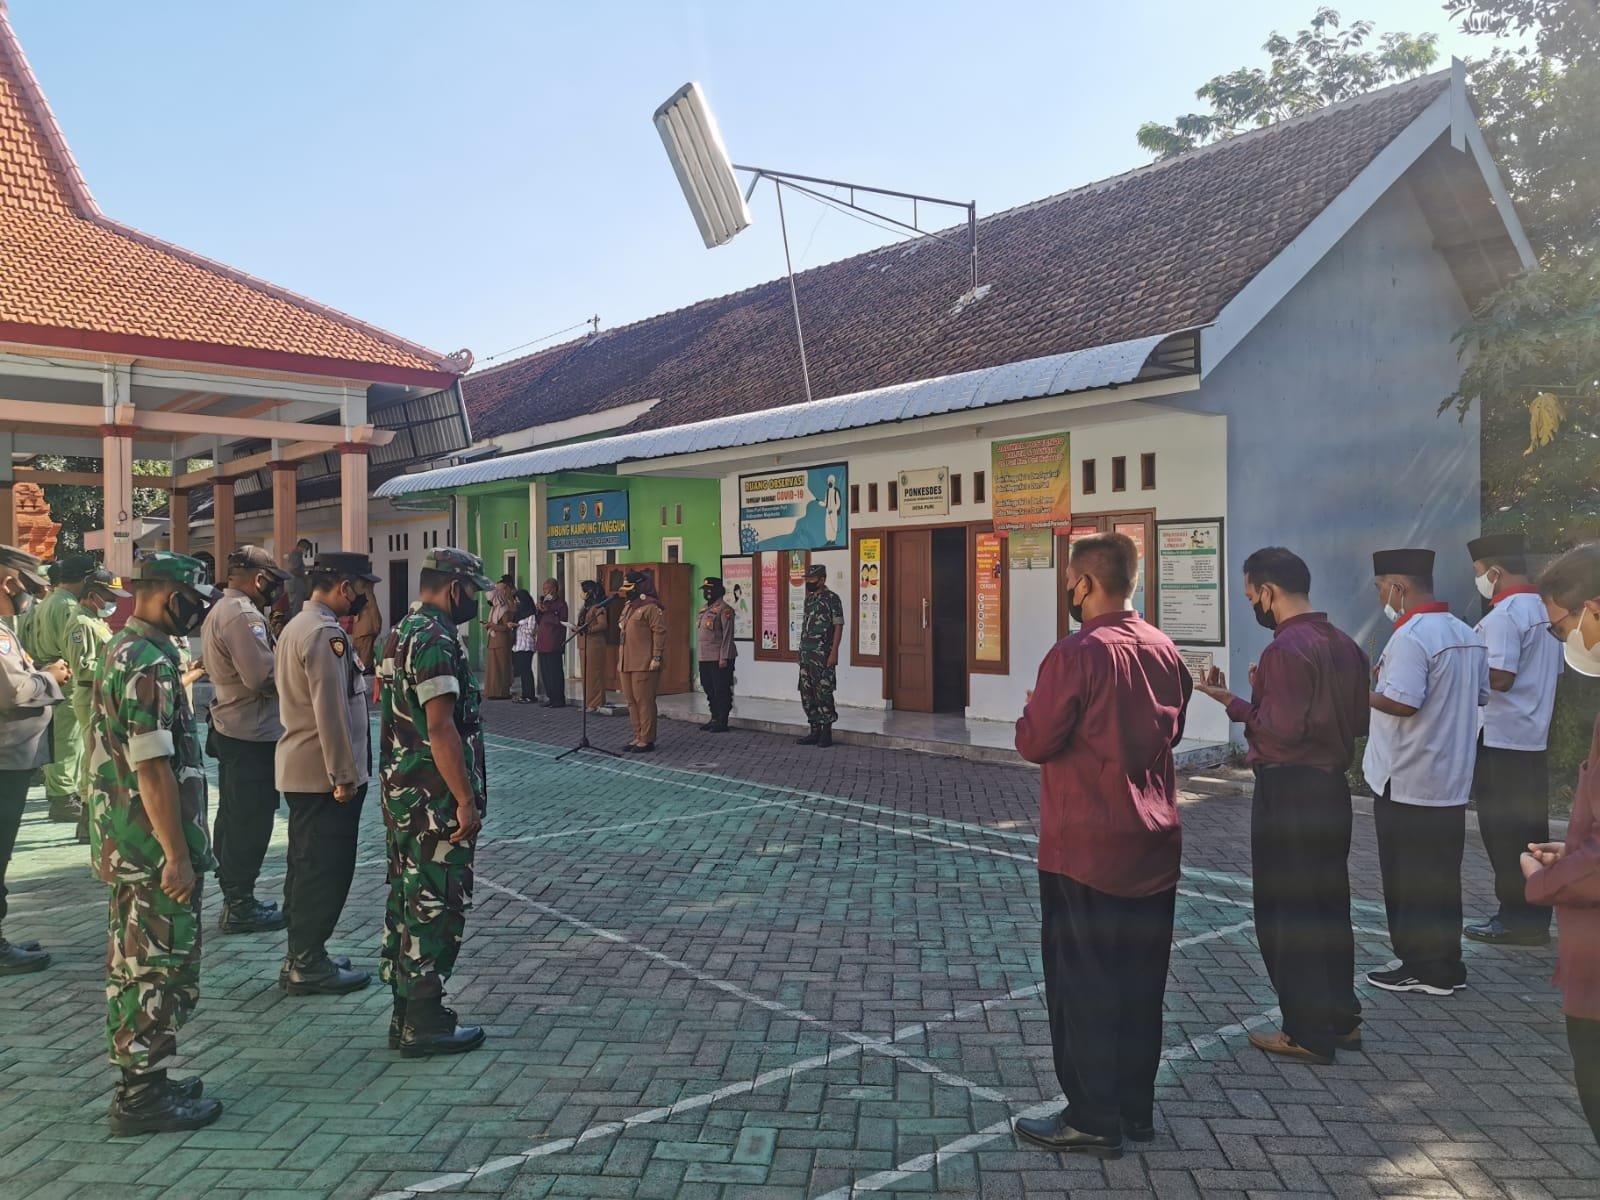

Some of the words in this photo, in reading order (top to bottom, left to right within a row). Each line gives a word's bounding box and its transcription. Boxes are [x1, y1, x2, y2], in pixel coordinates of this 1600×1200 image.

[744, 480, 768, 492] RUANG
[769, 475, 805, 489] OBSERVASI
[776, 489, 804, 501] COVID-19
[904, 485, 943, 497] PONKESDES
[547, 525, 570, 537] UMBUNG
[570, 522, 597, 535] KAMPUNG
[598, 519, 626, 533] TANGGUH
